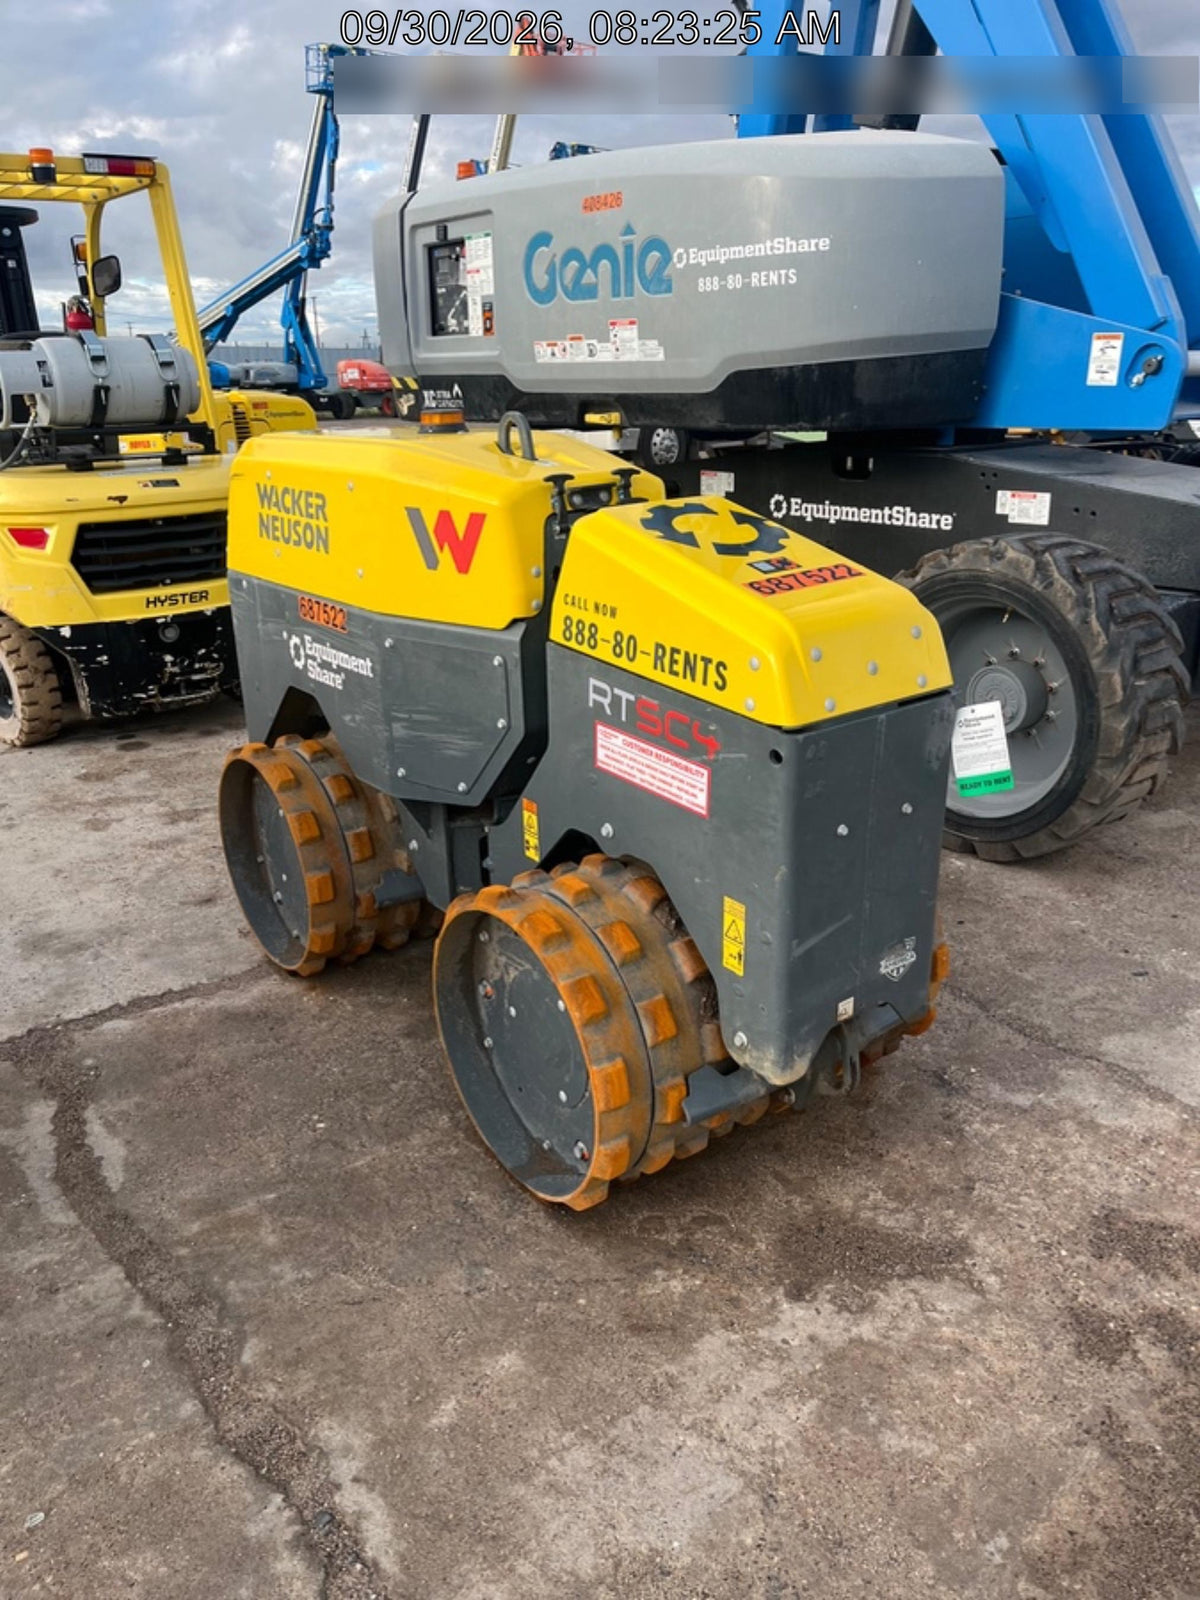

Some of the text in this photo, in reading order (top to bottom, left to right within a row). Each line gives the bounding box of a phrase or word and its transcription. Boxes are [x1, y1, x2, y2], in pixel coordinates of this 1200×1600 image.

[524, 221, 673, 307] Genie
[688, 235, 831, 266] EquipmentShare
[698, 268, 797, 292] 888-80-RENTS
[256, 482, 329, 523] WACKER
[790, 497, 954, 530] EquipmentShare
[258, 512, 330, 555] NEUSON
[748, 563, 863, 596] 687522
[145, 590, 209, 609] HYSTER
[299, 596, 347, 632] 687522
[564, 593, 618, 619] CALL NOW
[303, 634, 374, 678] Equipment
[562, 615, 729, 692] 888-80-RENTS
[306, 658, 344, 690] Share
[621, 738, 654, 757] CUSTOMER
